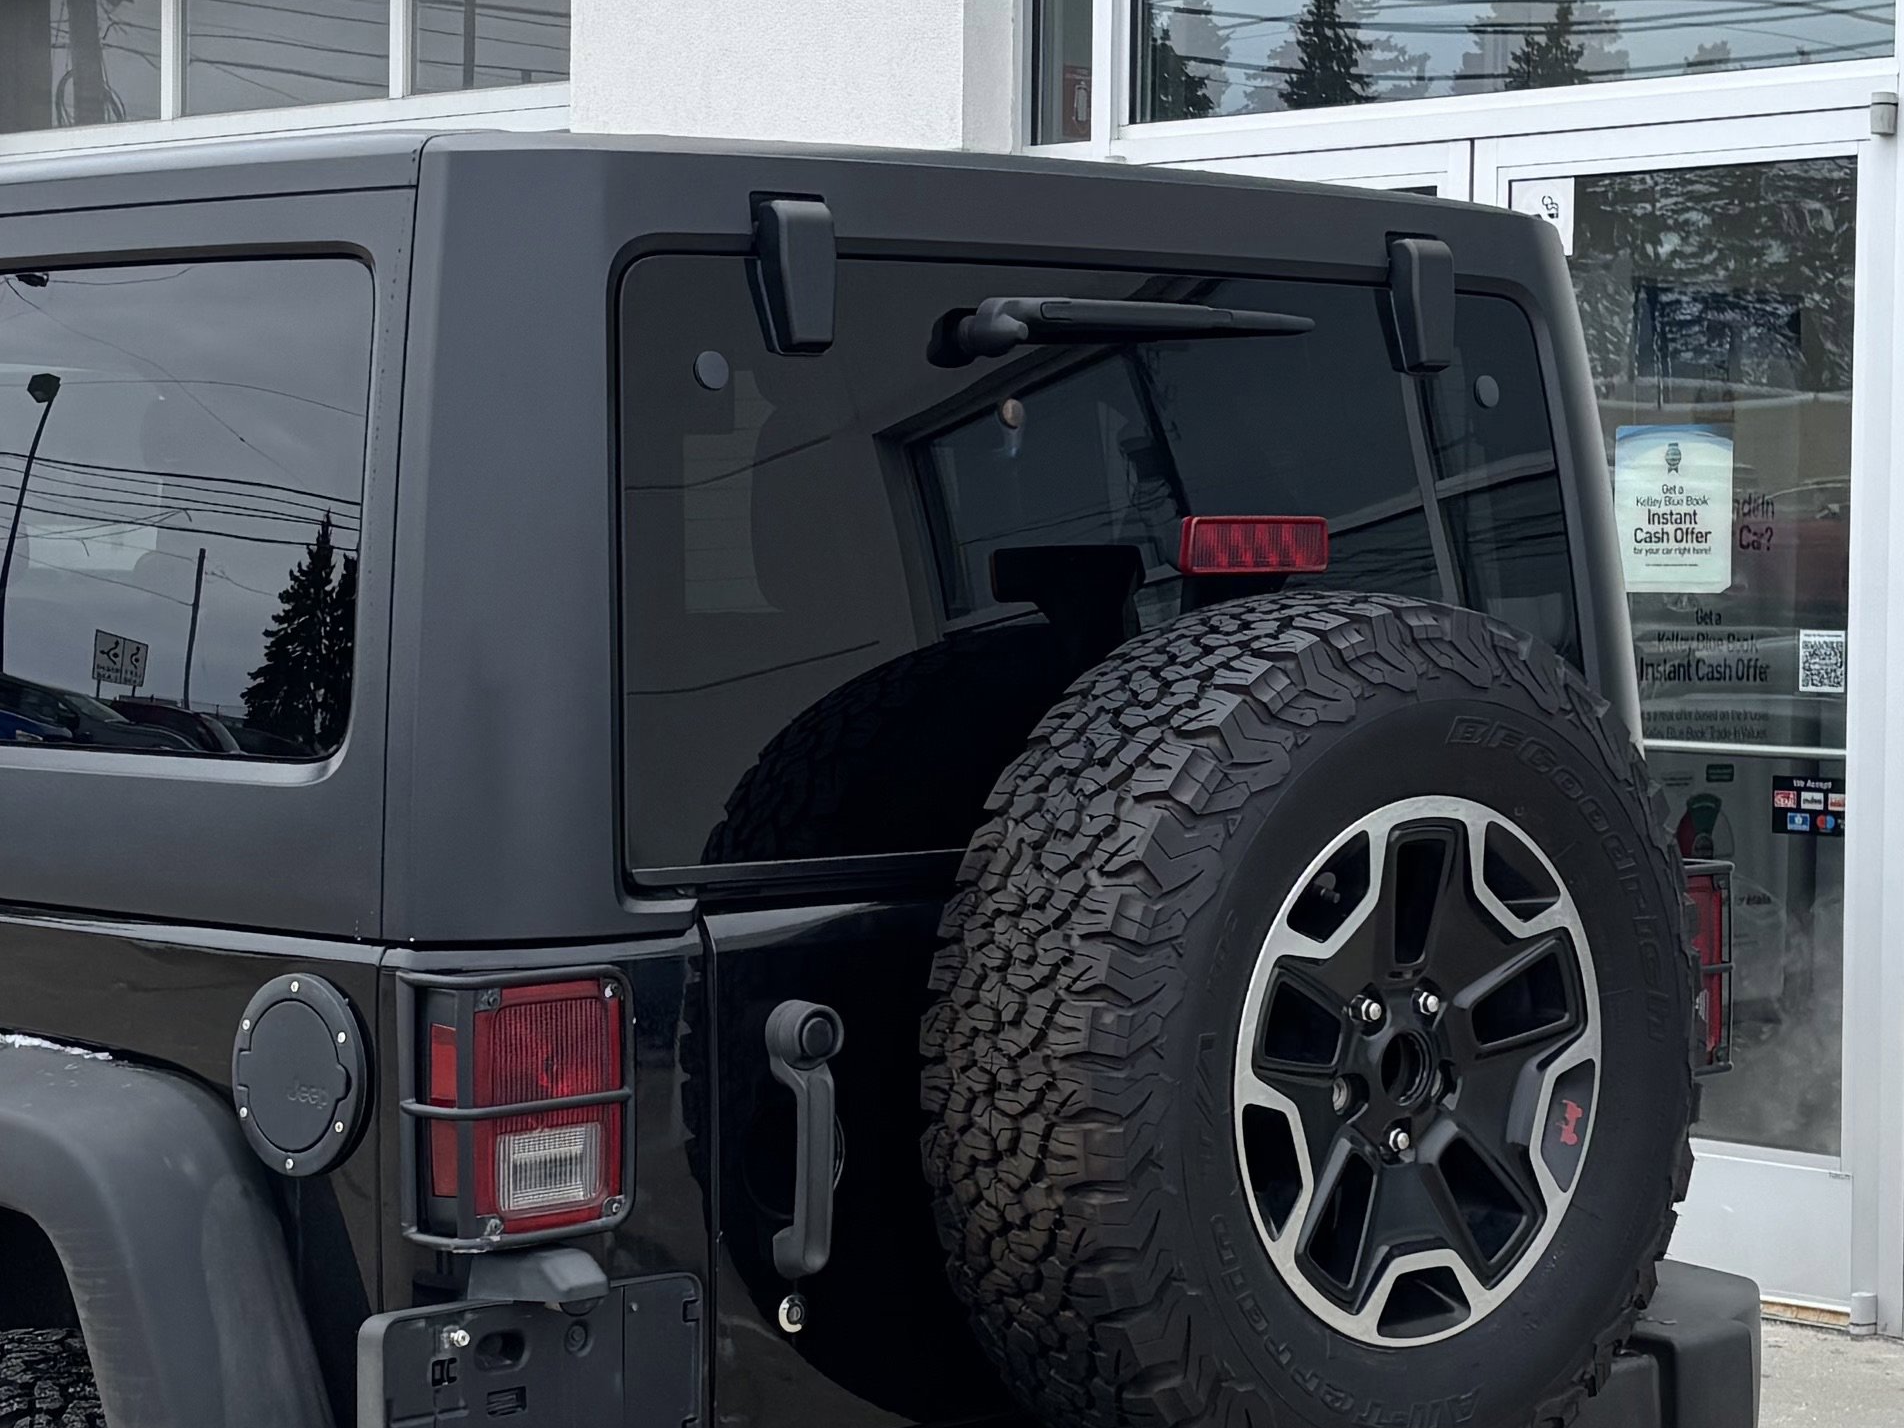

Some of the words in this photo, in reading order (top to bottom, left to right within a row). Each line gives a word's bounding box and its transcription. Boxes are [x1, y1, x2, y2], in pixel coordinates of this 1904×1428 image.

[1661, 484, 1676, 495] Get
[1647, 508, 1698, 525] Instant
[1634, 527, 1670, 544] Cash
[1674, 527, 1712, 544] Offer
[1695, 608, 1714, 626] Get
[1640, 656, 1692, 682] Instant
[1696, 657, 1733, 682] Cash
[1736, 657, 1771, 682] Offer
[286, 1076, 329, 1110] Jeep
